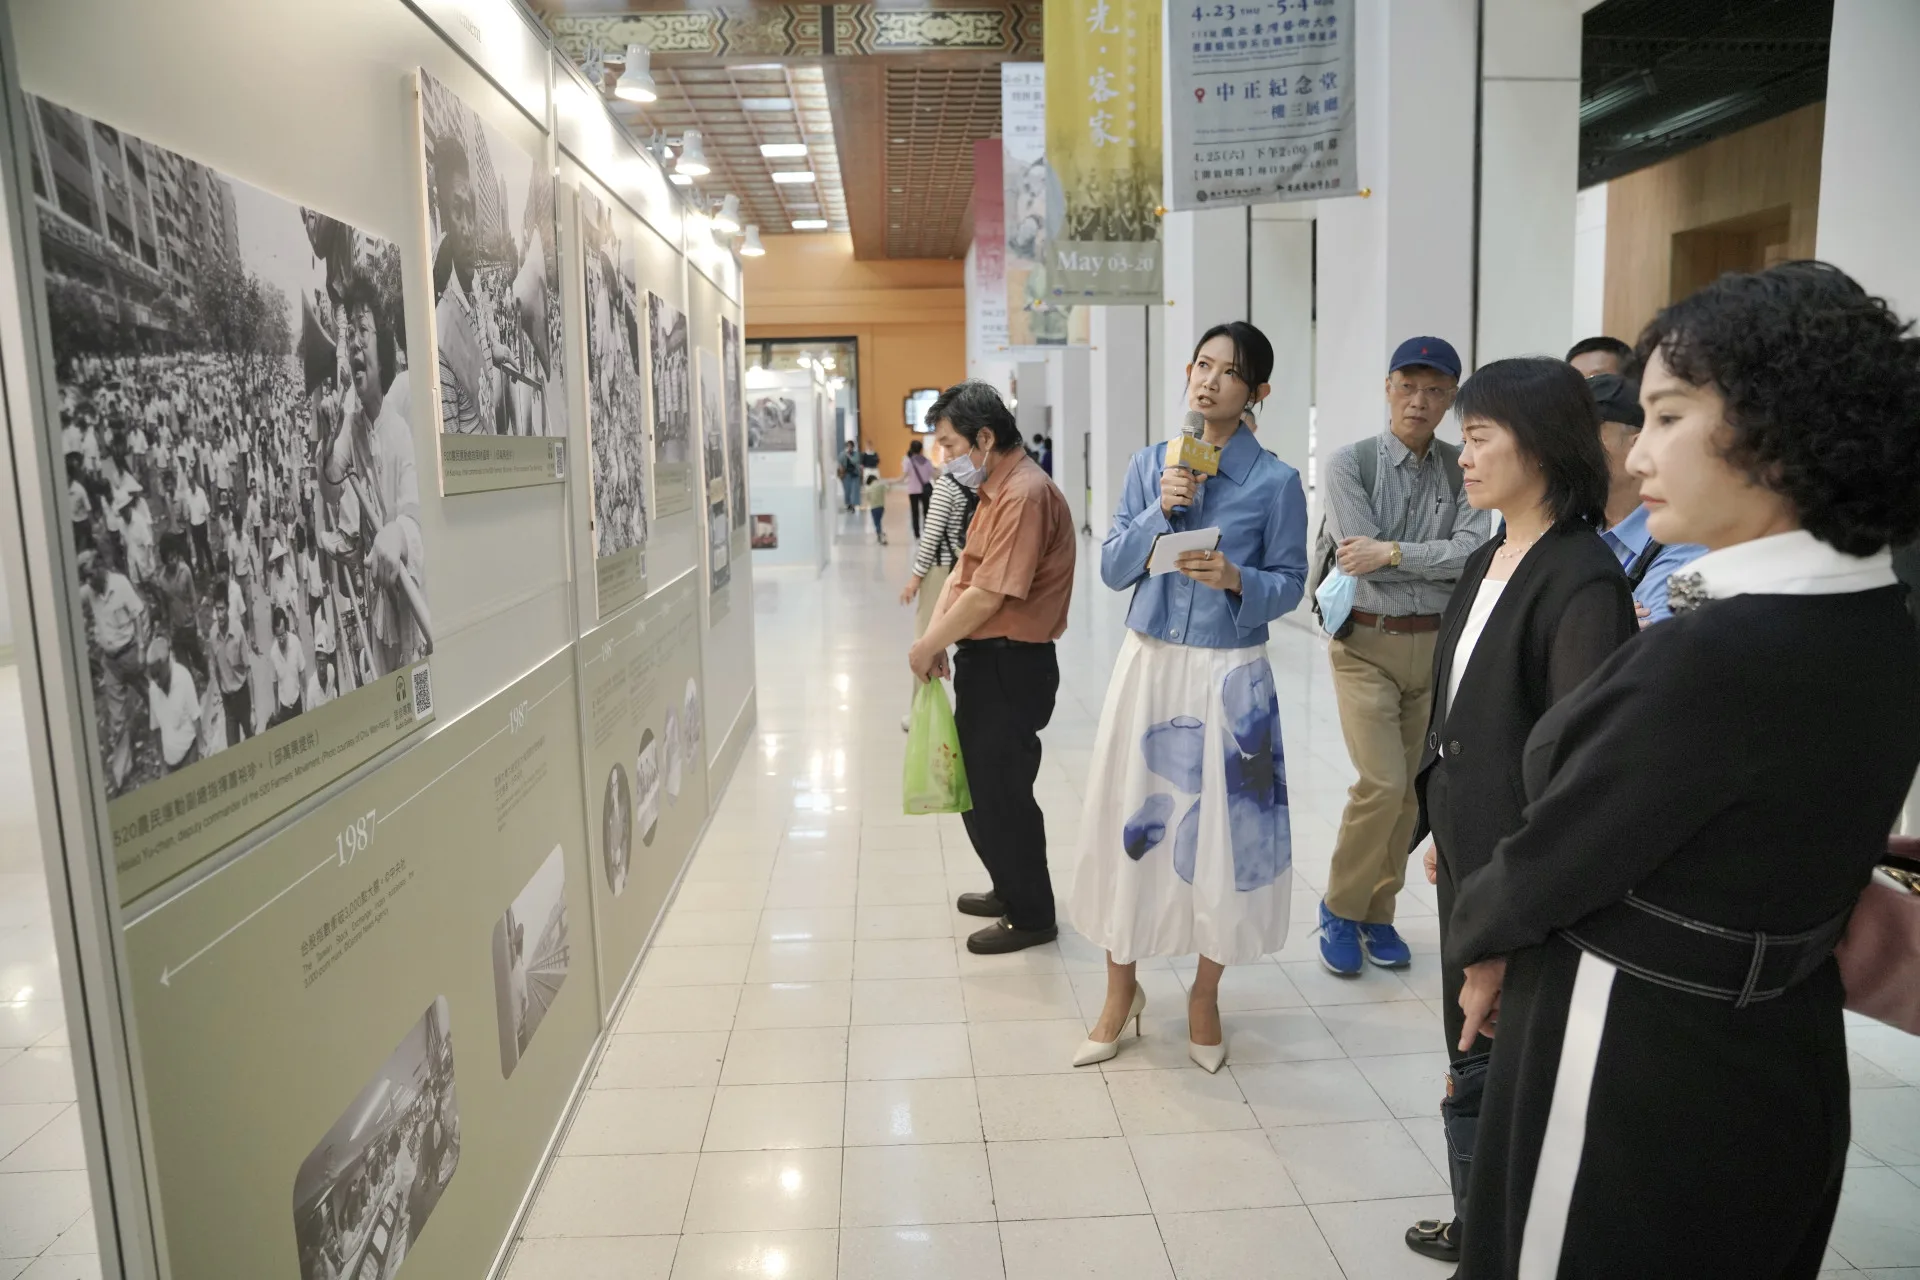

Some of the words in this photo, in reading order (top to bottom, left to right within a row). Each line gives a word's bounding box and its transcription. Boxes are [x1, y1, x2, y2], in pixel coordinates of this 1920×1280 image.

[1191, 4, 1236, 22] 4.23
[1216, 72, 1338, 102] 中正紀念堂
[1056, 250, 1105, 277] May
[509, 699, 529, 734] 1987
[335, 808, 377, 868] 1987
